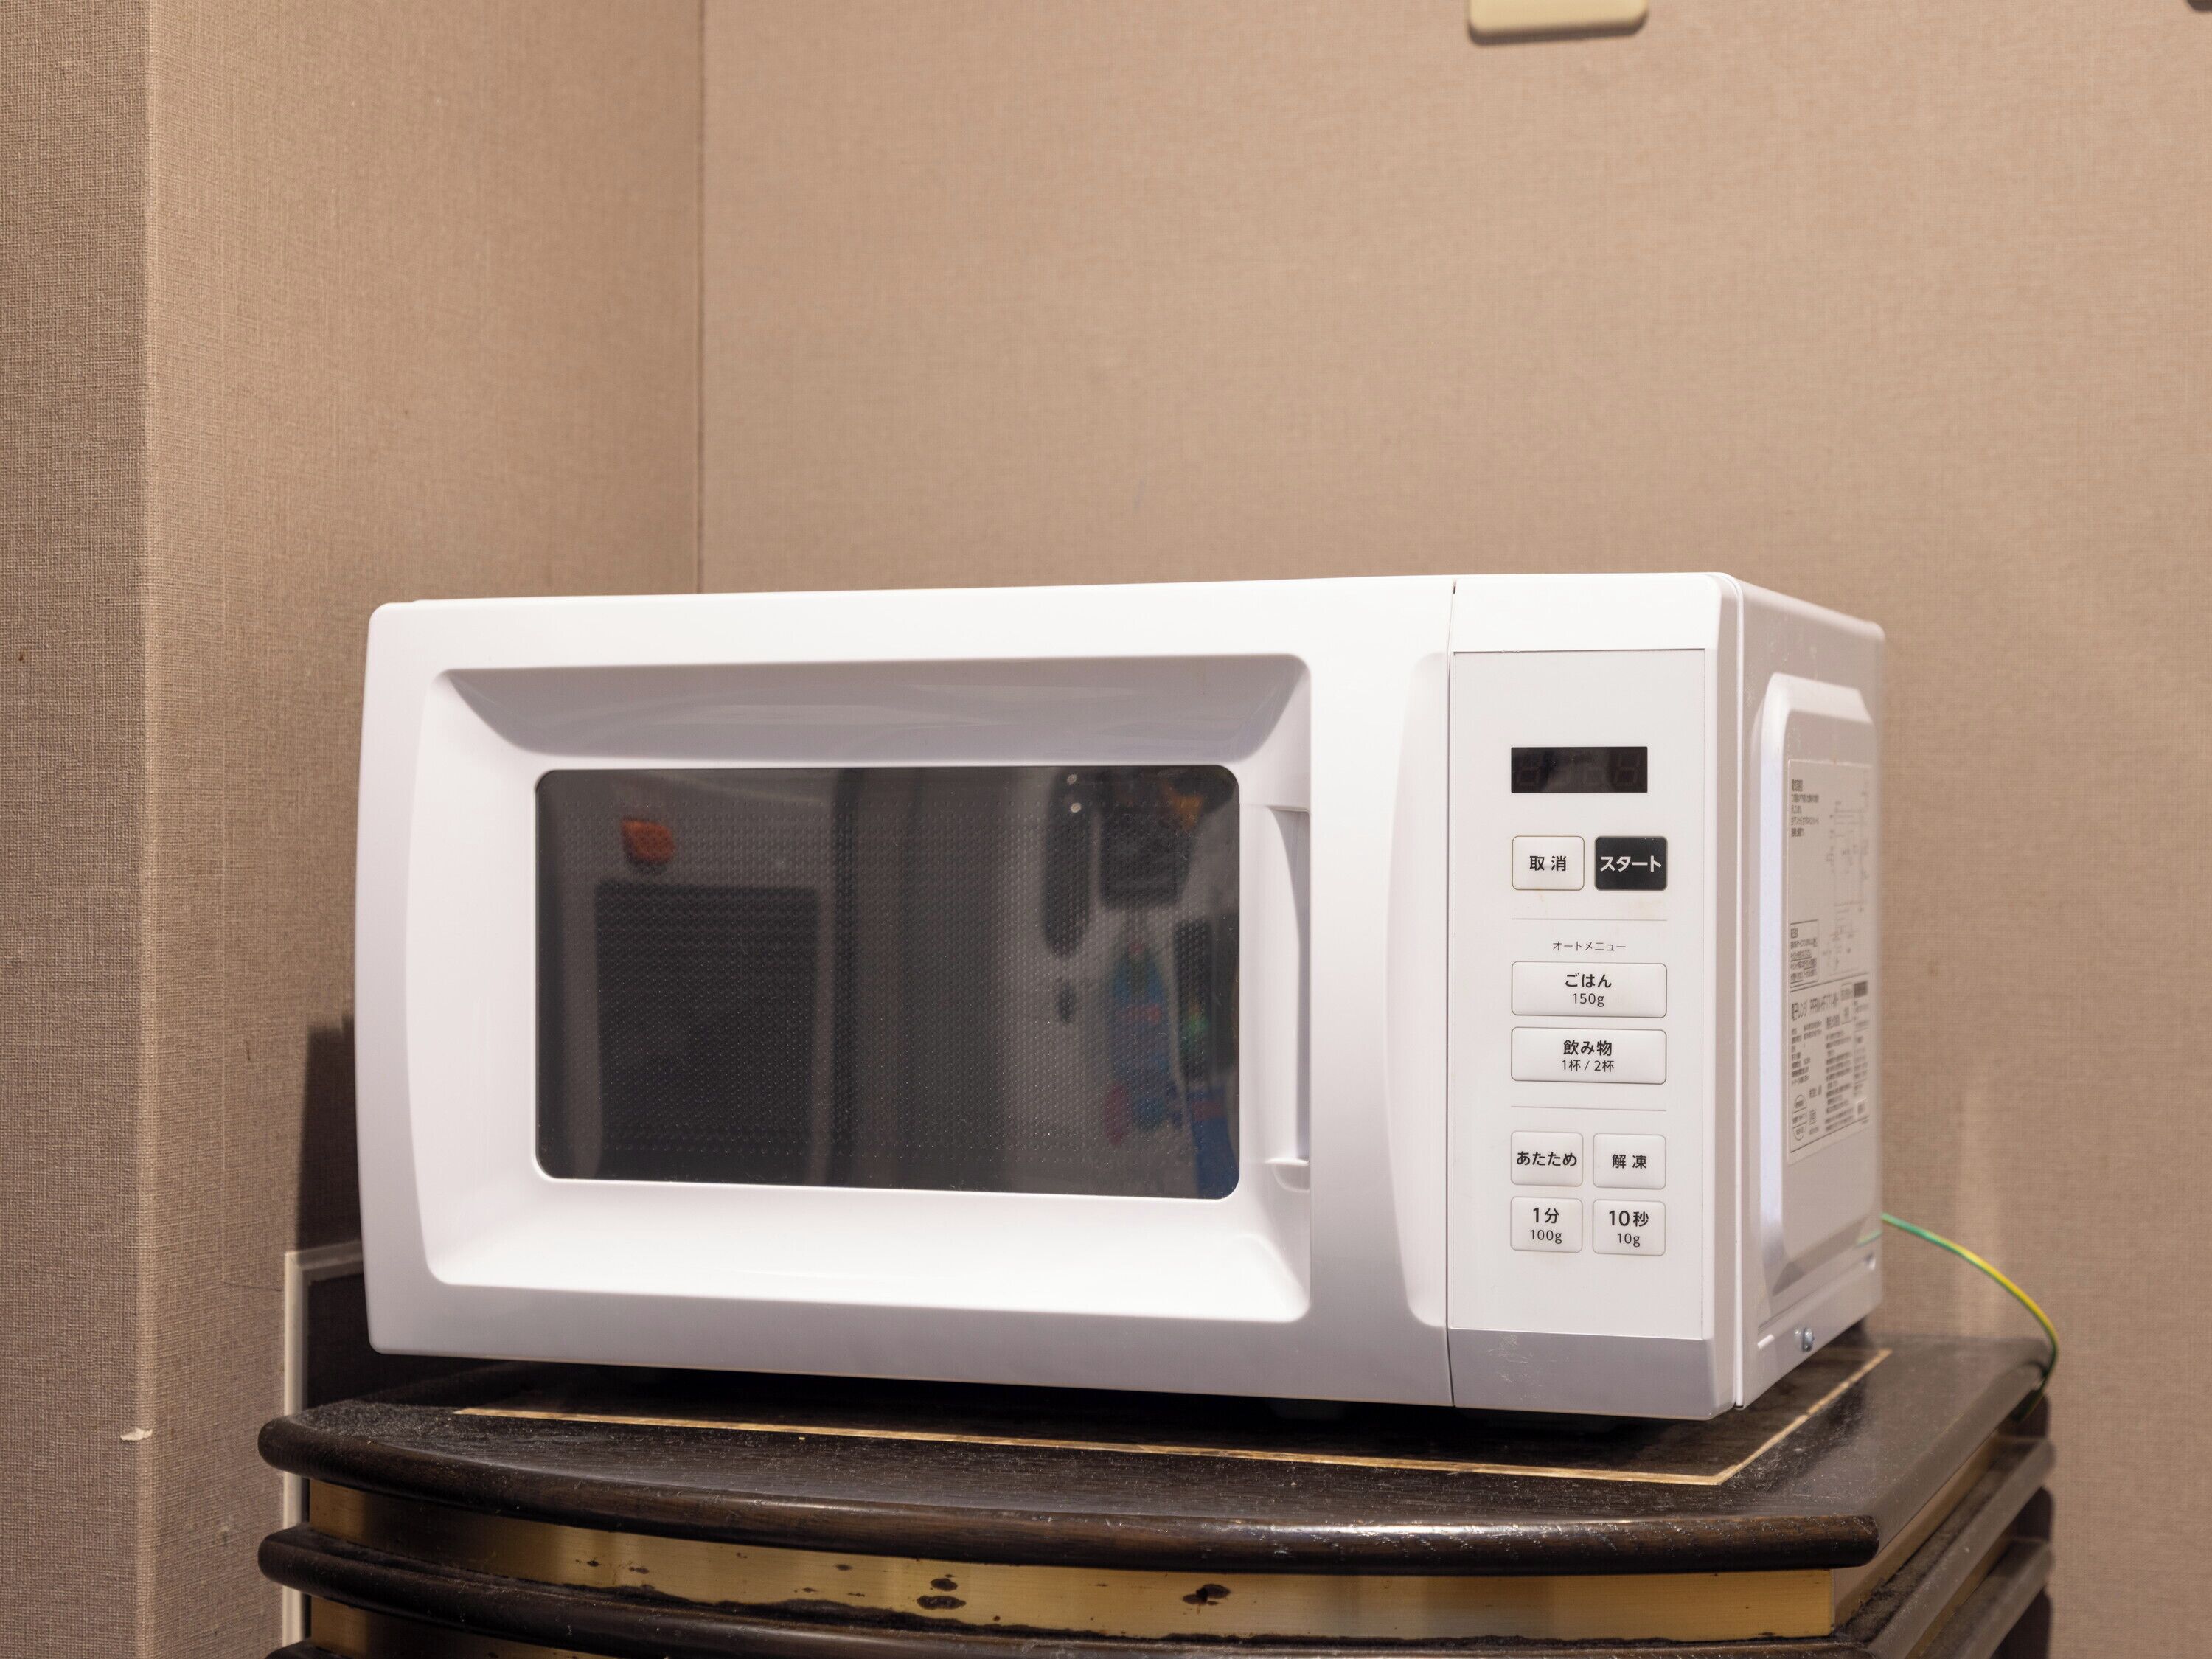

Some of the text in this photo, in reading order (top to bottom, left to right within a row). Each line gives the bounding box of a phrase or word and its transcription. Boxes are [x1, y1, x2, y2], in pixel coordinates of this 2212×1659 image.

[1529, 855, 1567, 872] 取消
[1600, 855, 1662, 873] スタート
[1553, 941, 1627, 952] オートメニュー
[1565, 973, 1613, 989] ごはん
[1573, 993, 1604, 1008] 150g
[1563, 1040, 1613, 1057] 飲み物
[1517, 1151, 1577, 1167] あたため
[1612, 1154, 1647, 1169] 解凍
[1533, 1208, 1560, 1225] 1分
[1609, 1210, 1649, 1227] 10秒
[1531, 1229, 1562, 1245] 100g
[1617, 1233, 1641, 1248] 10g
